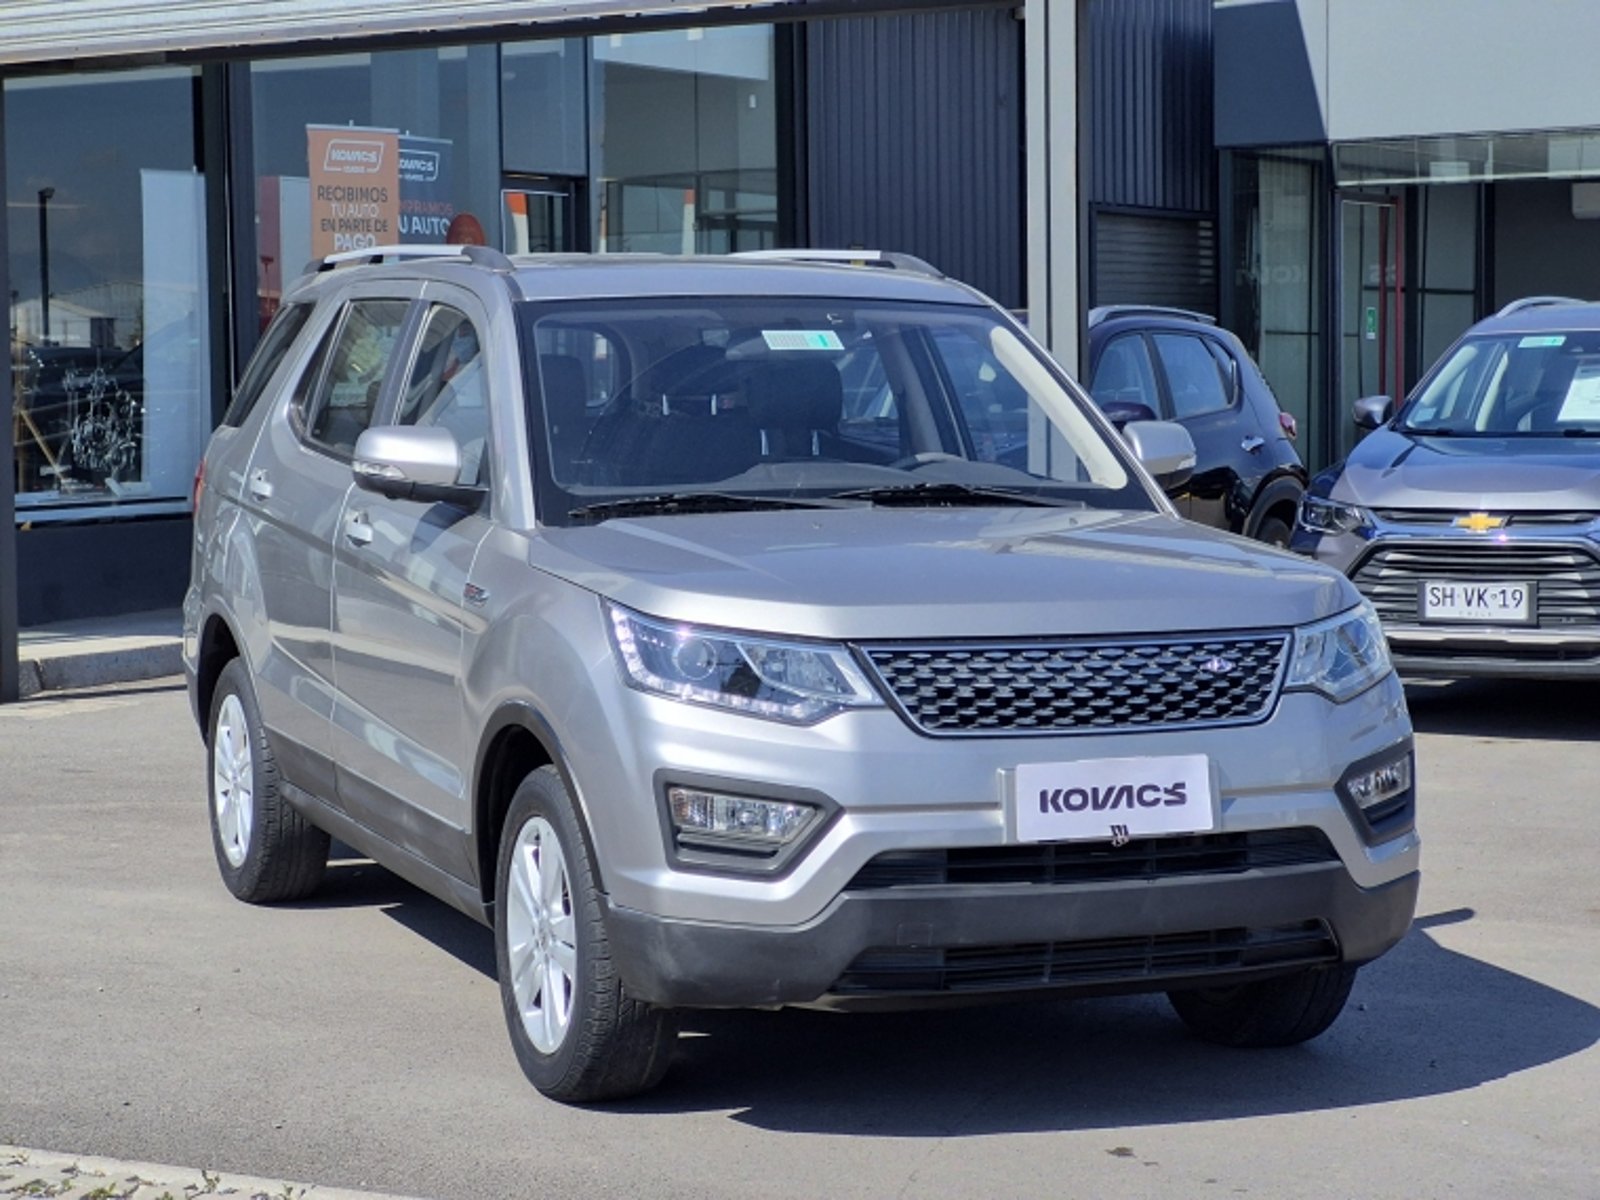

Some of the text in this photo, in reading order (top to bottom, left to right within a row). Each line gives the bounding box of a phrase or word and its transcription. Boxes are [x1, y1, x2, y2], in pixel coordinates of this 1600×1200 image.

[317, 185, 388, 203] RECIBIMOS
[331, 203, 380, 218] TU AUTO
[321, 218, 388, 233] EN PARTE DE
[398, 215, 450, 236] U AUTO
[334, 233, 376, 251] PAGO
[1039, 781, 1188, 813] KOVACS
